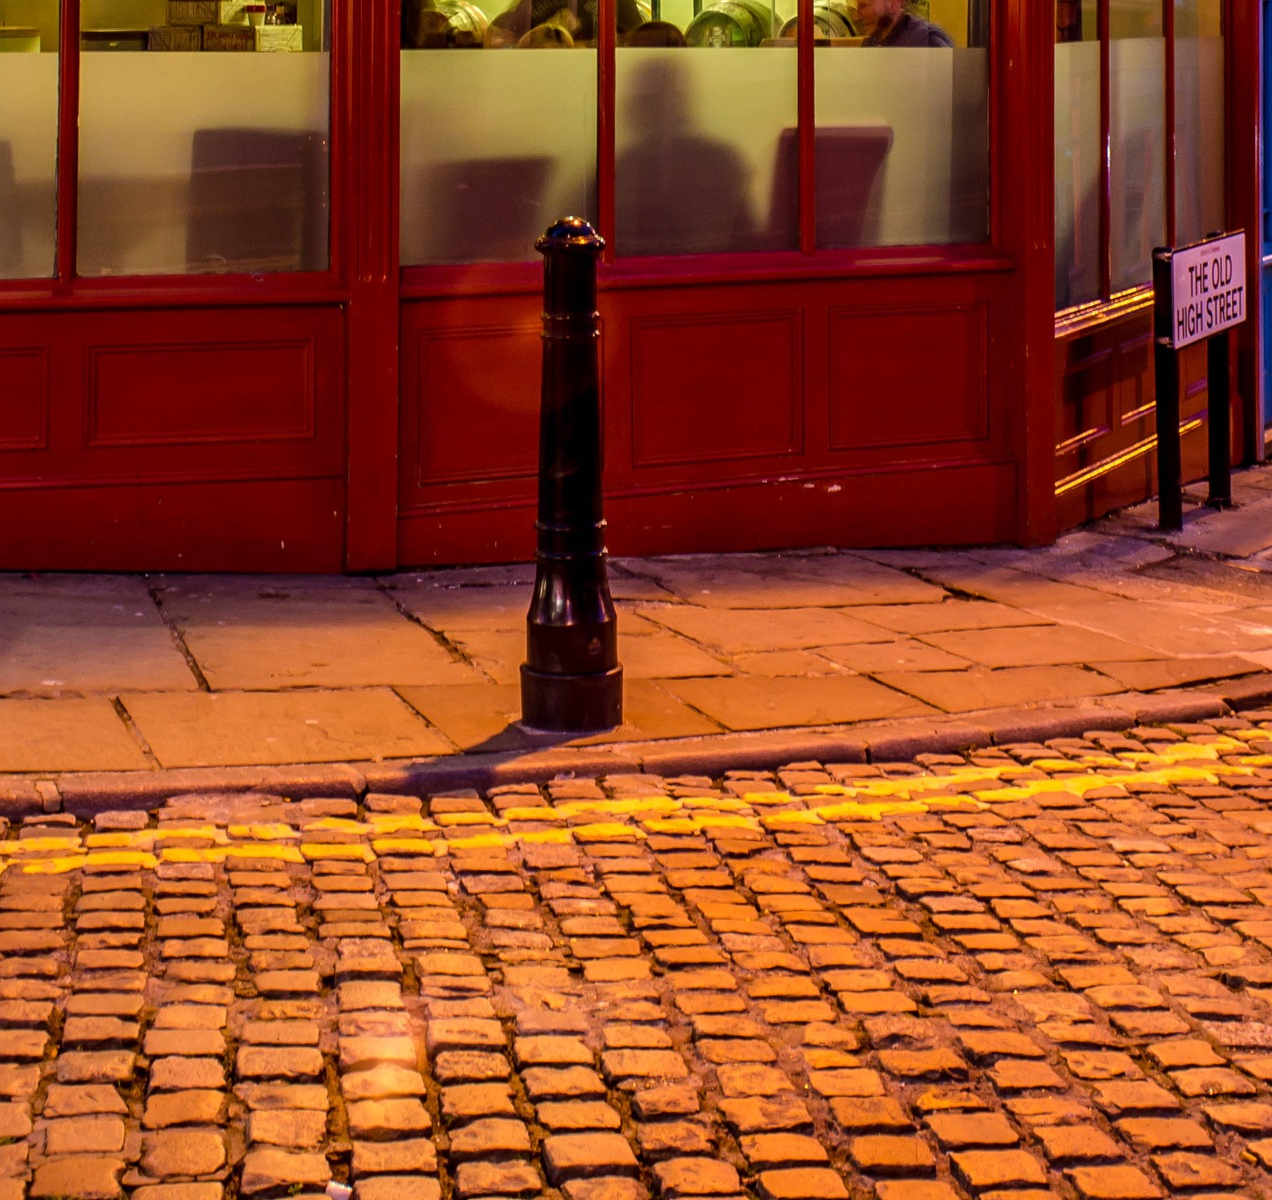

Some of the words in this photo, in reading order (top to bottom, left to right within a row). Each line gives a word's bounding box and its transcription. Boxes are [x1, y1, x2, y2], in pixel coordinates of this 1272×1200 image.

[1188, 262, 1209, 298] THE
[1211, 255, 1233, 290] OLD
[1177, 301, 1204, 341] HIGH
[1206, 286, 1244, 329] STREET
